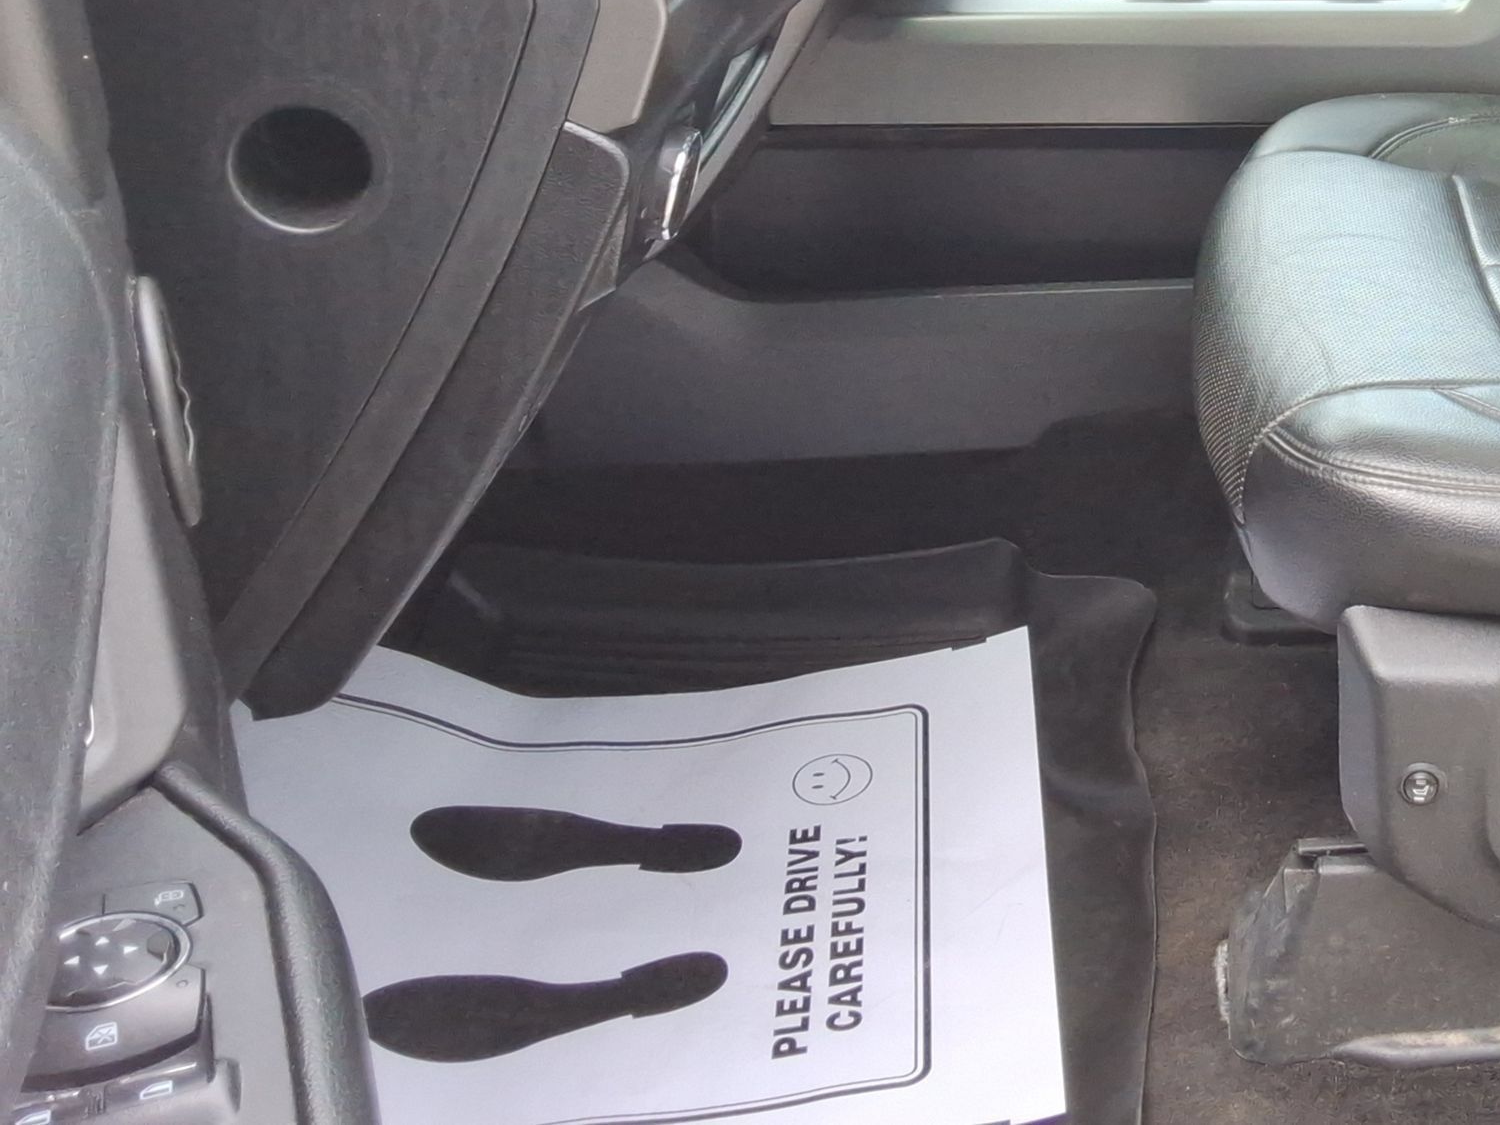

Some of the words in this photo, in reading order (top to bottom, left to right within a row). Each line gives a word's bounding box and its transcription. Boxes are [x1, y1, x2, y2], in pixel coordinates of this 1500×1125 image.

[782, 825, 822, 915] DRIVE
[825, 835, 868, 1032] CAREFULLY!
[771, 924, 815, 1060] PLEASE
